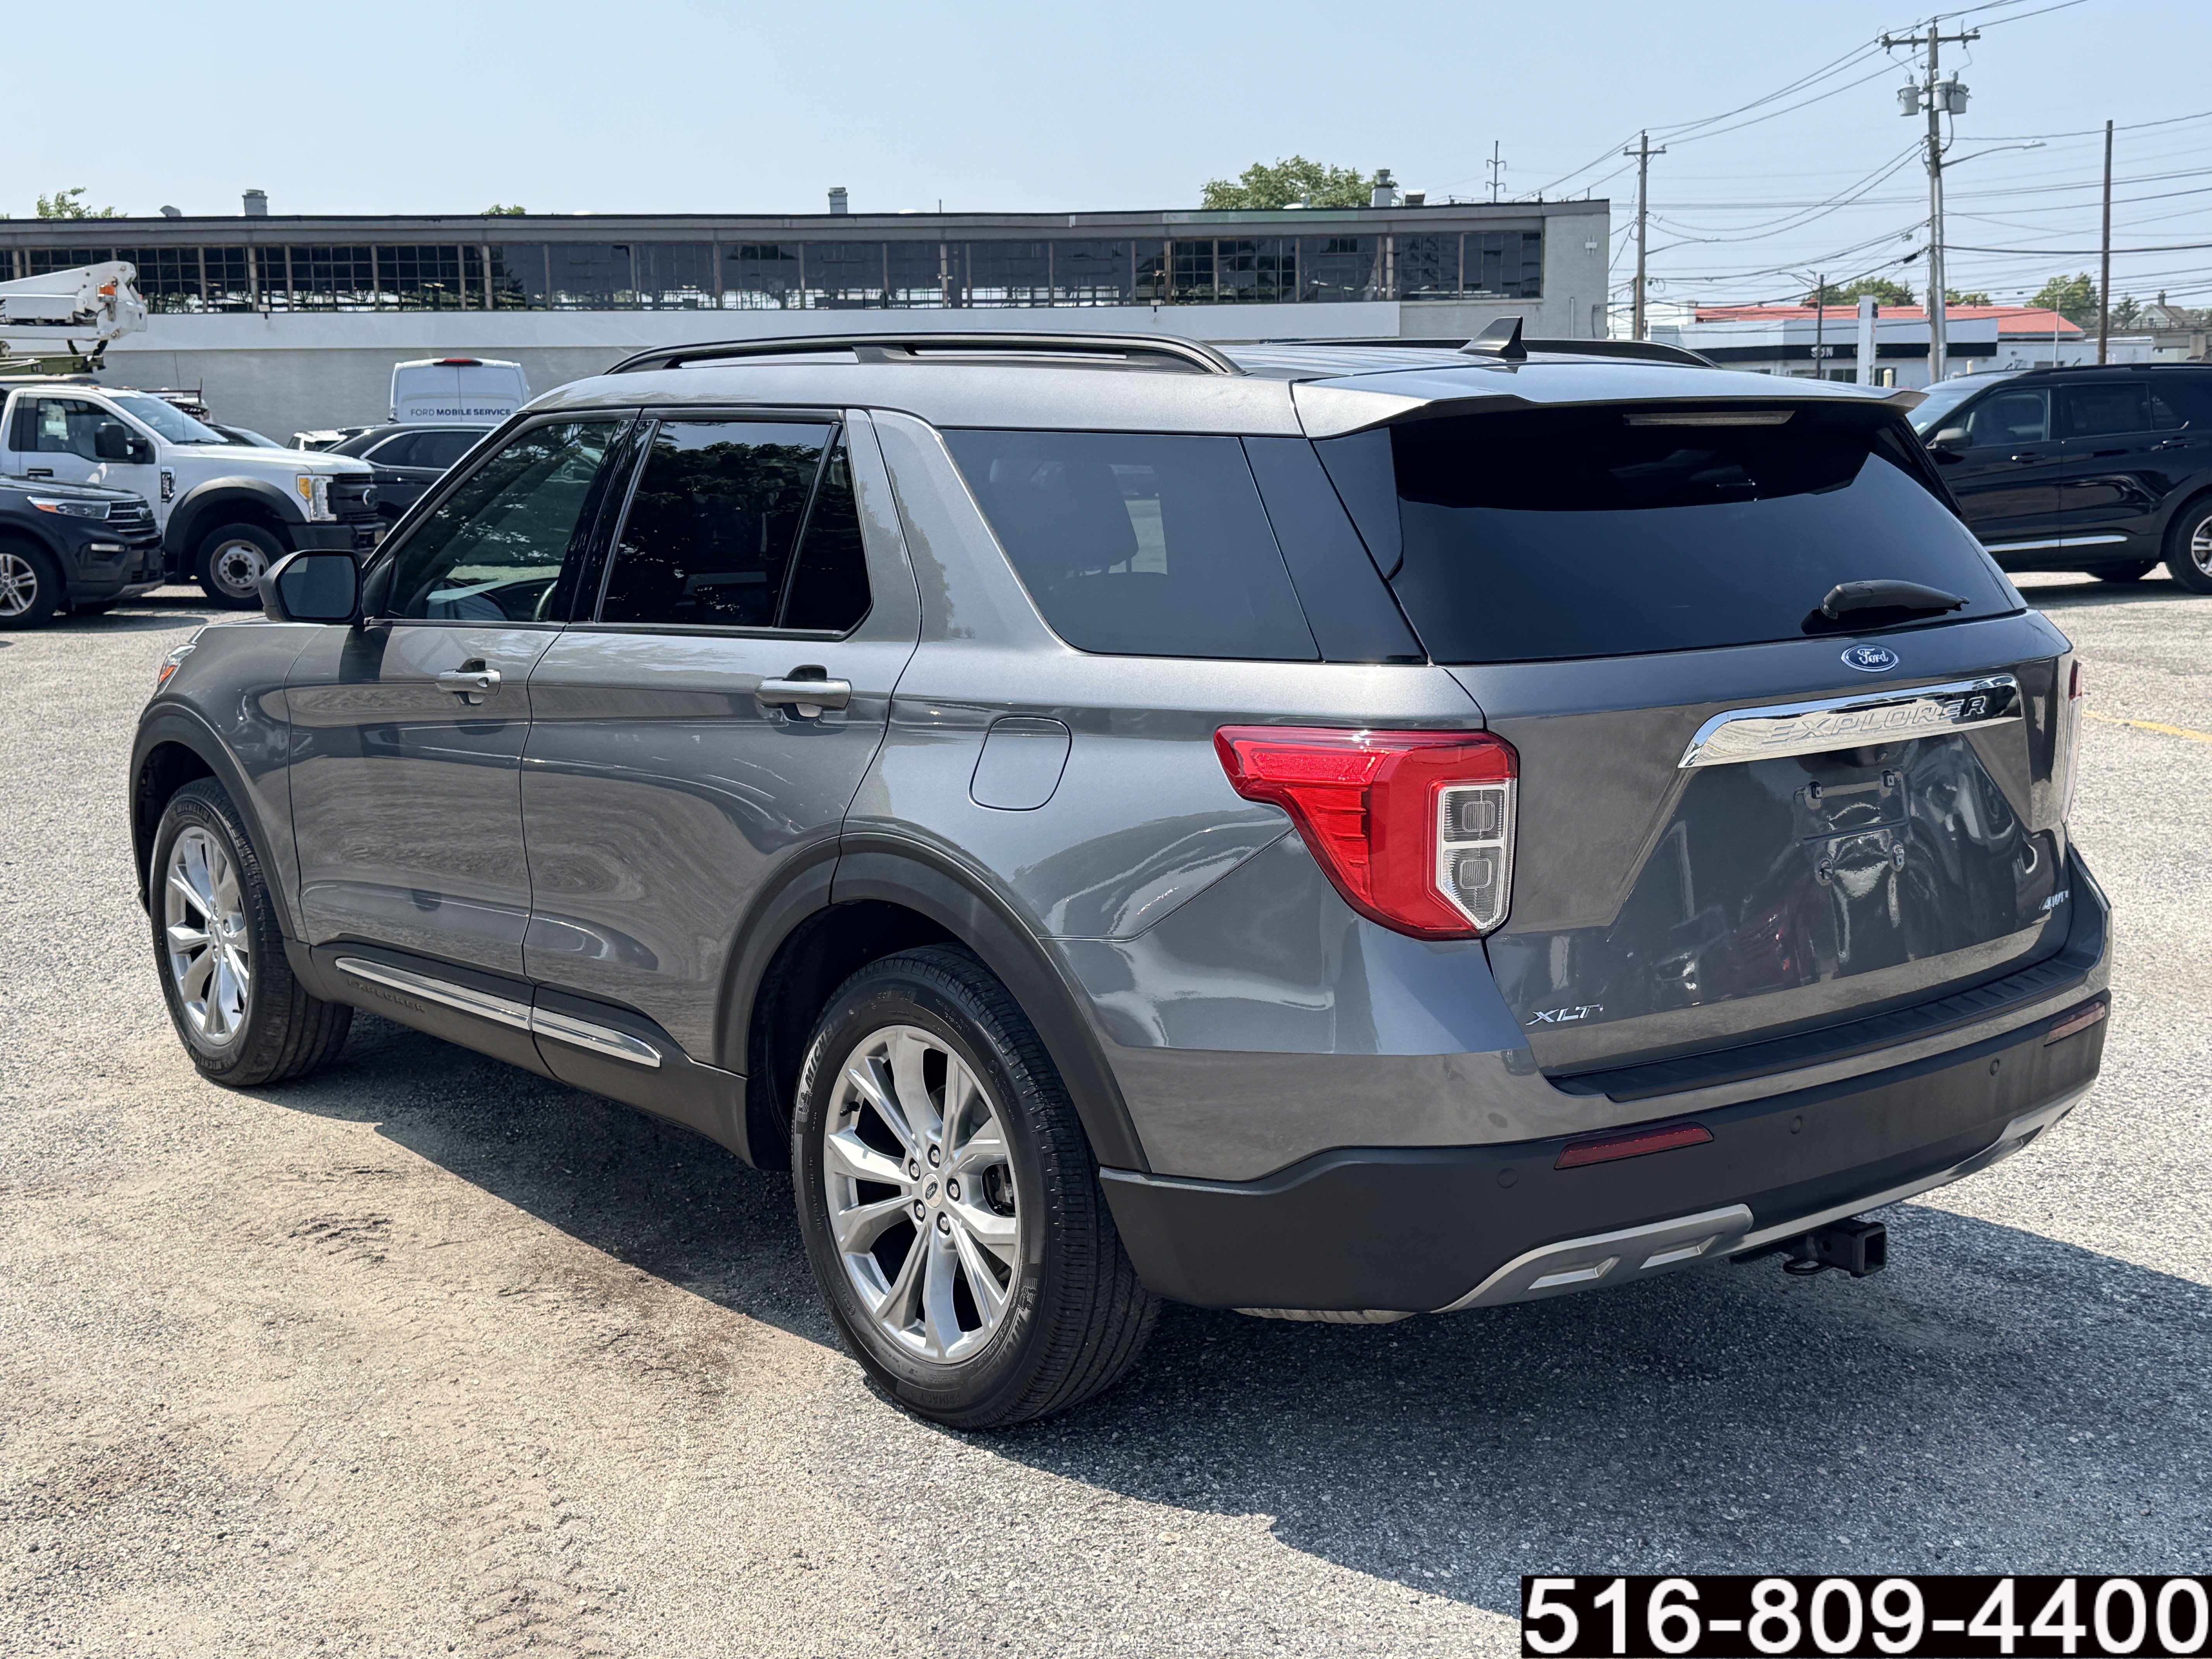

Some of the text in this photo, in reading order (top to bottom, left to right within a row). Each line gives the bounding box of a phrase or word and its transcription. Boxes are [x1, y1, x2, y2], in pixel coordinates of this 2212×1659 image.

[1857, 647, 1889, 665] Ford
[1761, 696, 1986, 745] EXPLORER
[347, 978, 425, 1013] EXPLORER
[1525, 1004, 1604, 1025] XLT
